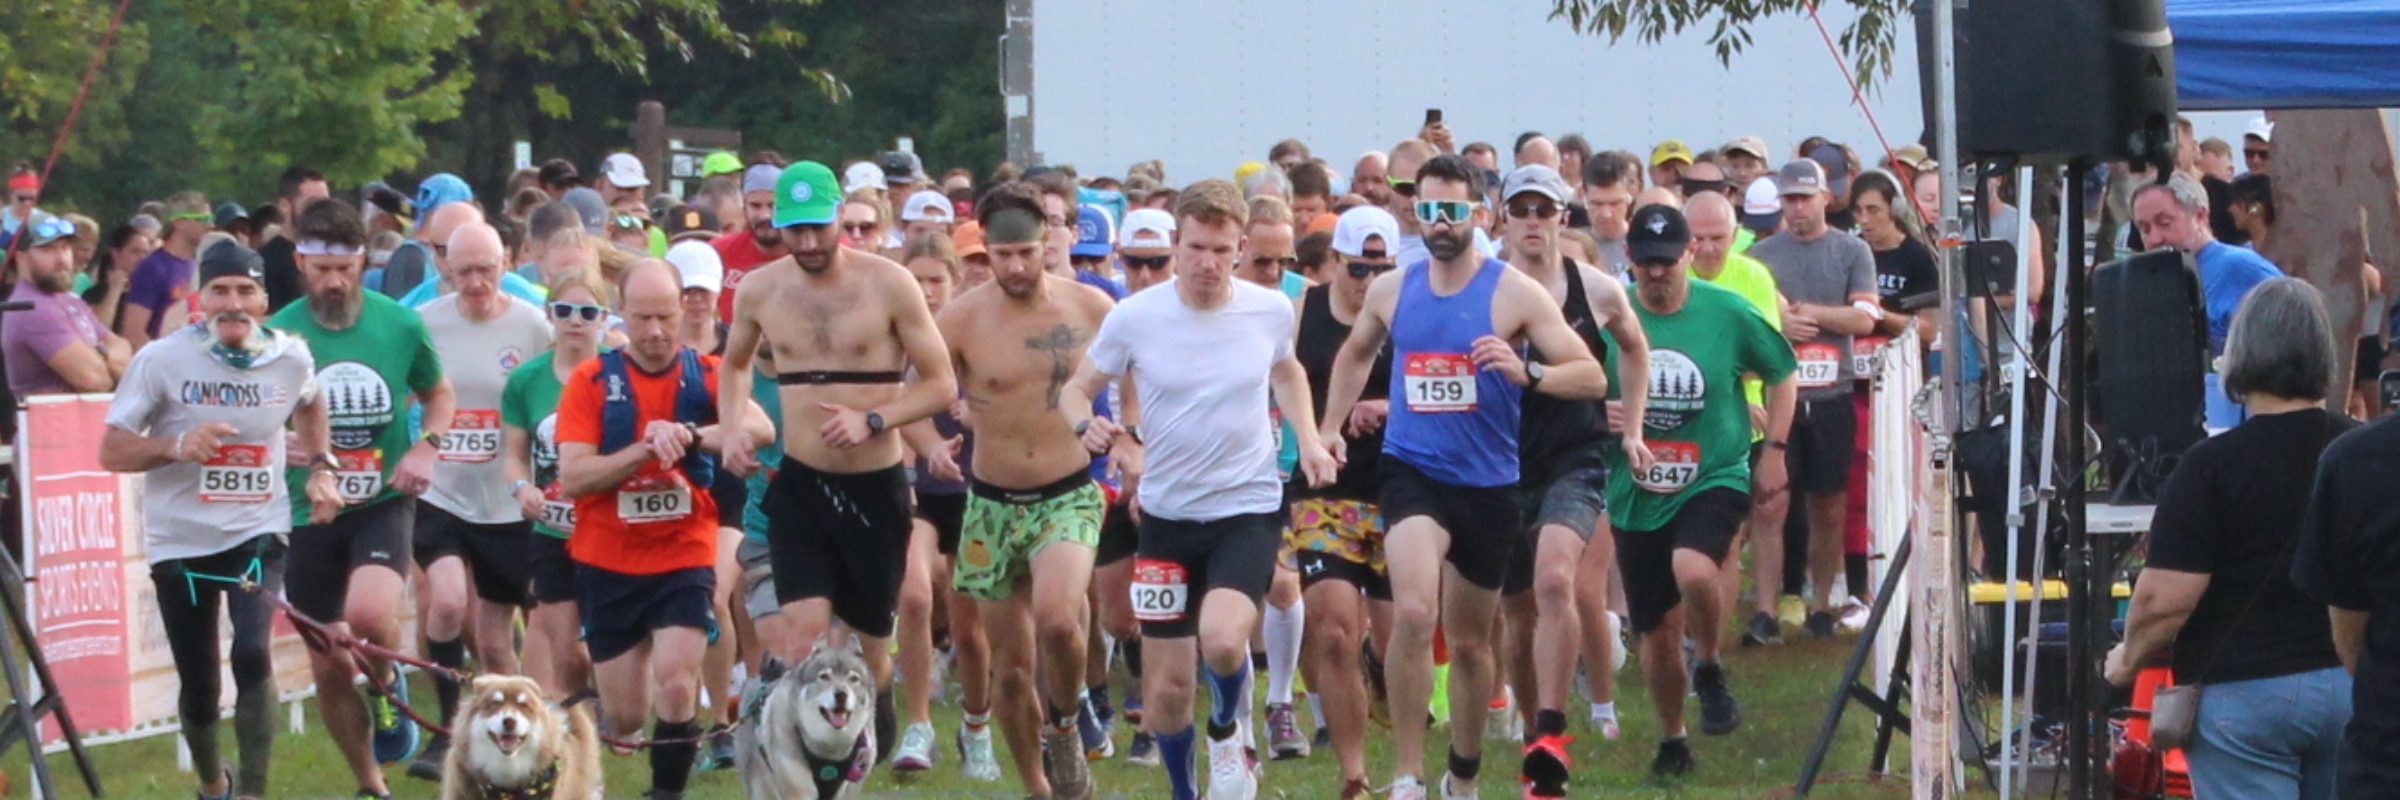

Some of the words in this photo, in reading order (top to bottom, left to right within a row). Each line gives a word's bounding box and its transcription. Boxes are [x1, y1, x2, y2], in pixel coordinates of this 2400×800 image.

[1418, 380, 1463, 401] 159
[440, 433, 497, 451] 5765
[205, 470, 271, 491] 5819
[336, 475, 377, 495] 767
[633, 493, 679, 513] 160
[37, 494, 76, 555] SILVER
[77, 491, 116, 549] CIRCLE
[541, 504, 576, 525] 576
[1135, 588, 1175, 610] 120
